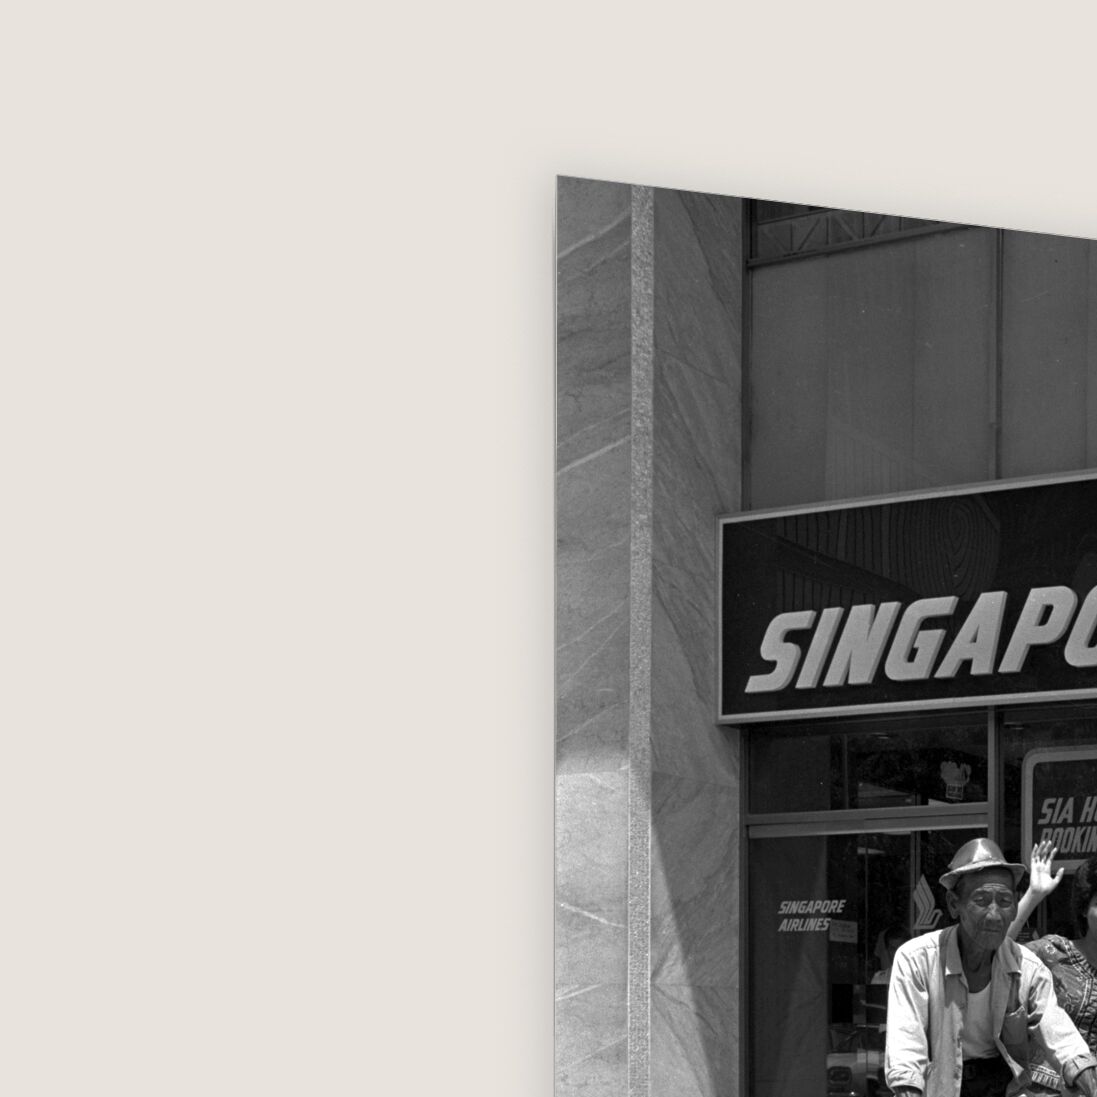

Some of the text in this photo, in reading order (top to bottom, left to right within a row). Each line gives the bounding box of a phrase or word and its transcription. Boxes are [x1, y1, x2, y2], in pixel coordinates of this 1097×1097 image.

[1037, 797, 1074, 825] SIA
[778, 900, 847, 914] SINGAPORE
[778, 918, 831, 932] AIRLINES
